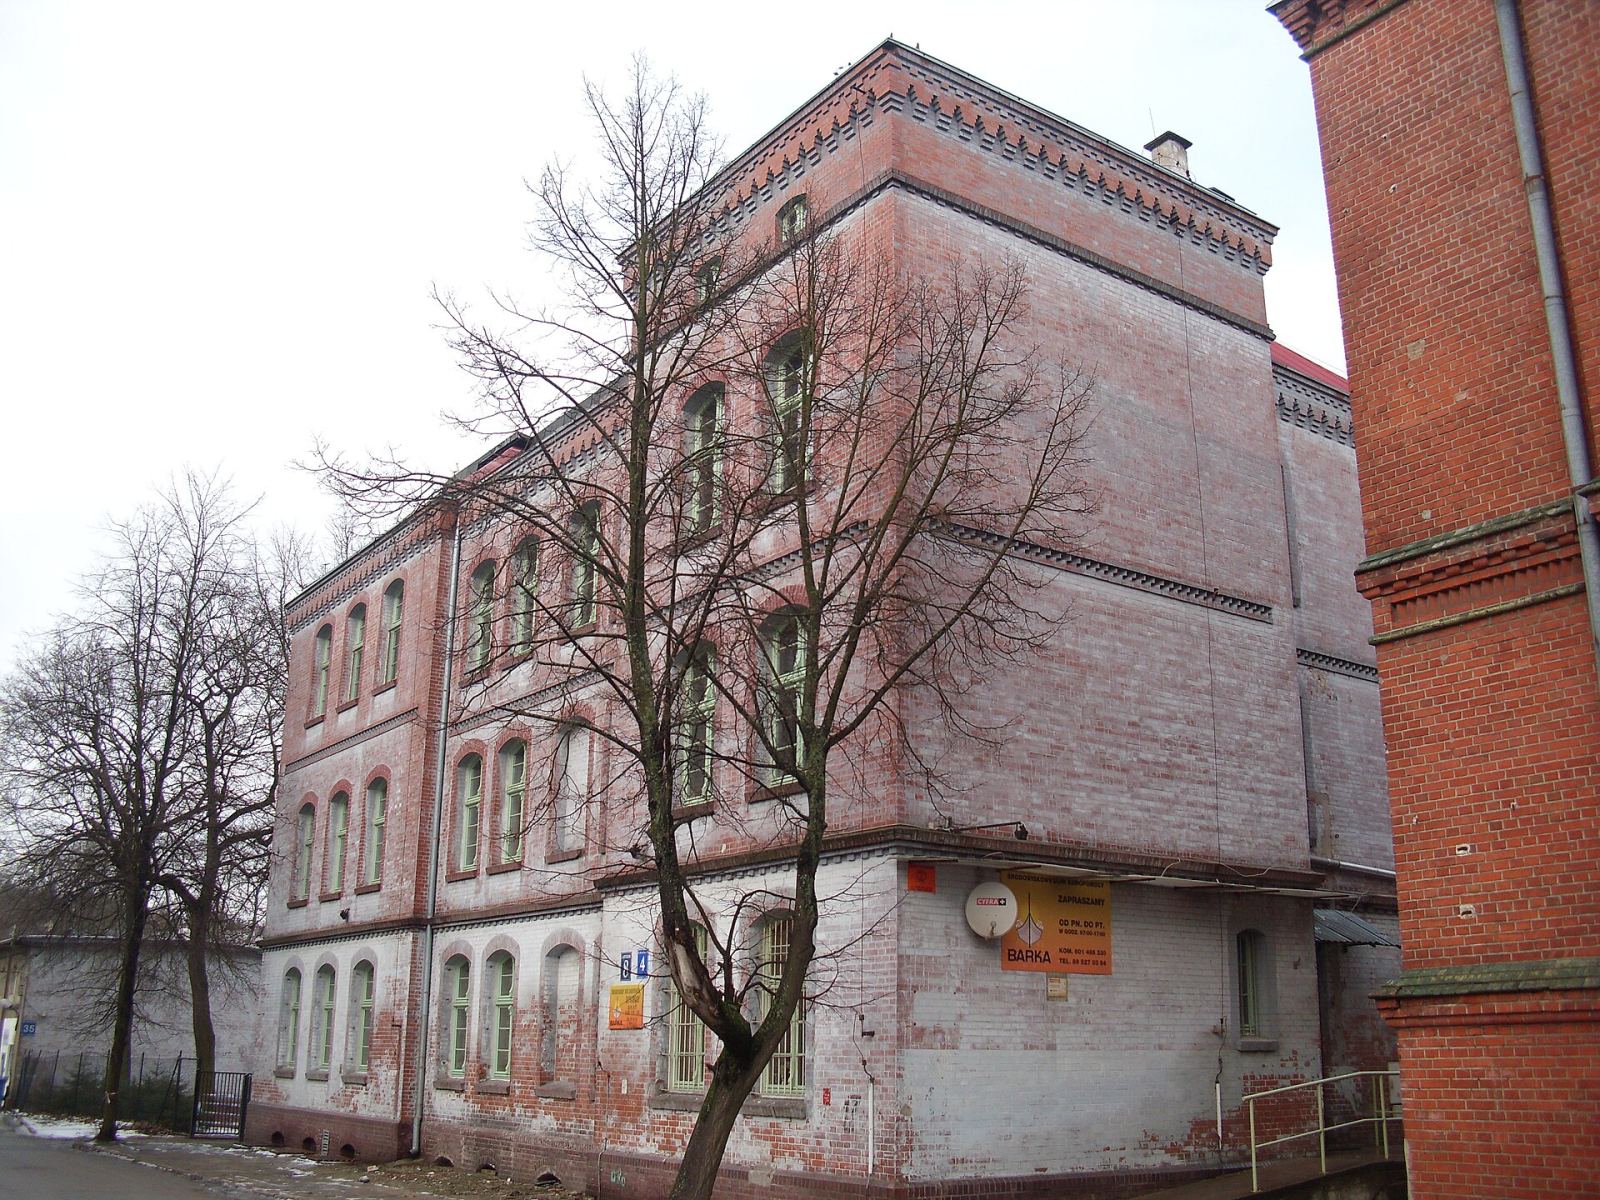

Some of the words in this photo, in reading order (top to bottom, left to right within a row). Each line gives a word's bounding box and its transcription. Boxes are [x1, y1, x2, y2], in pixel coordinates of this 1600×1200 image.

[1058, 895, 1105, 906] ZAPRASZAMY
[1008, 949, 1051, 963] BARKA
[640, 956, 645, 971] 4
